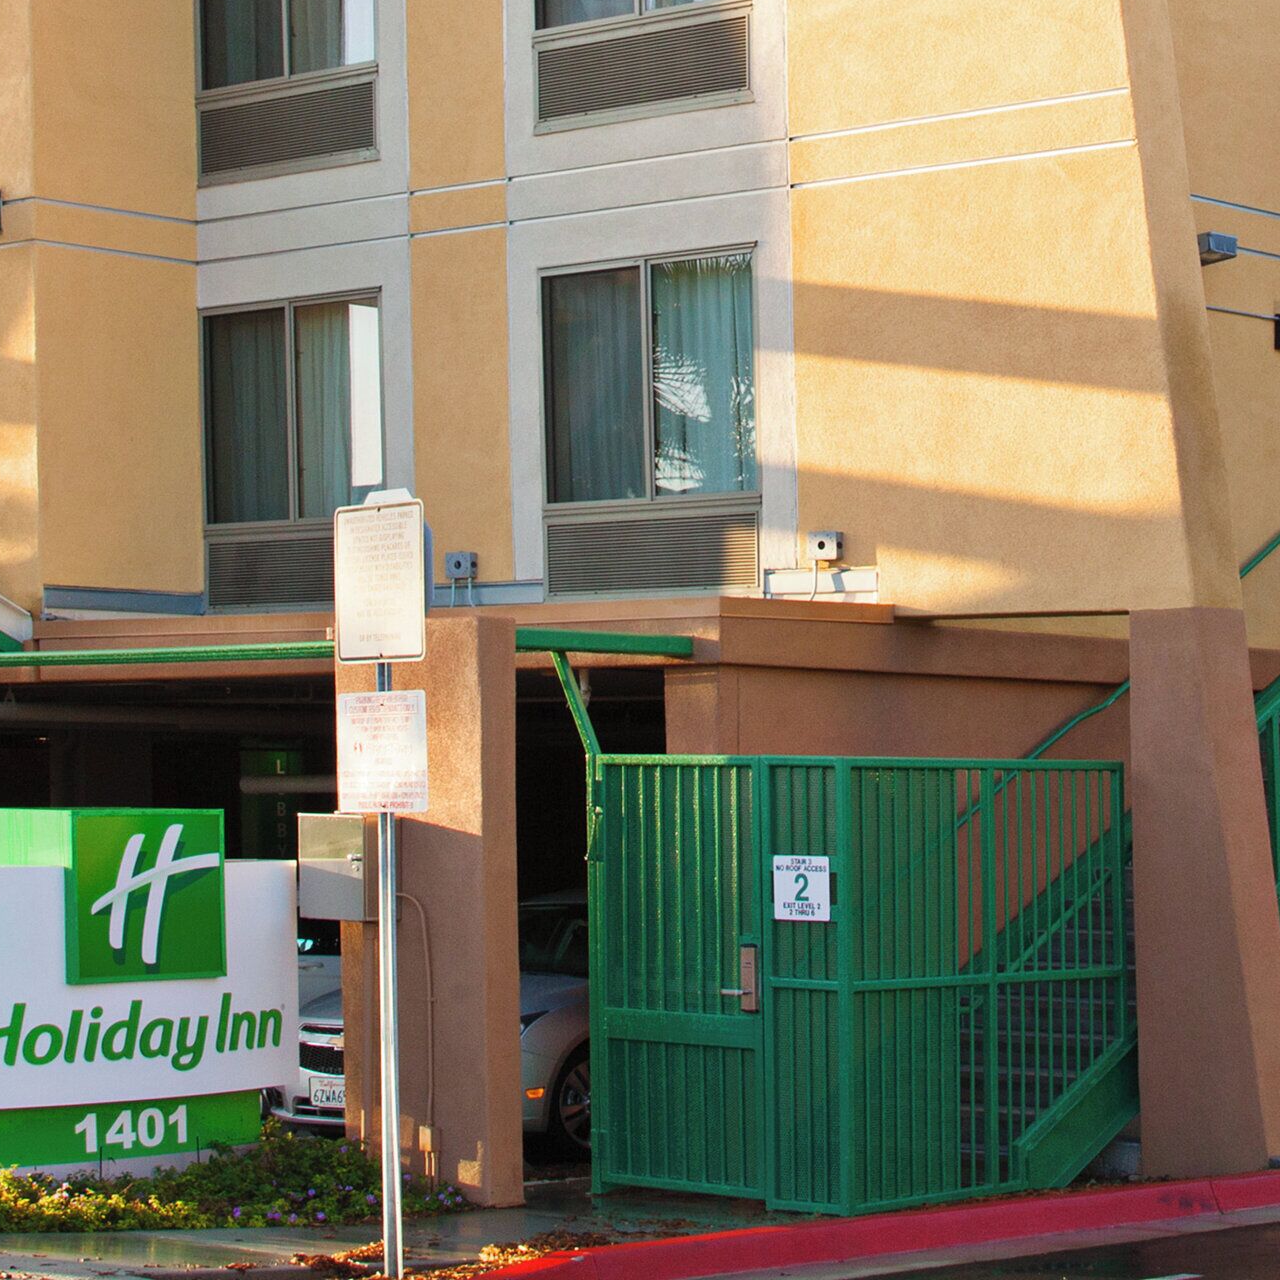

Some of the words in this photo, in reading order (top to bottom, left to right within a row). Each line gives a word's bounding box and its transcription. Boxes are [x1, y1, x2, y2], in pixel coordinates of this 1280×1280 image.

[276, 759, 288, 858] LBBY
[794, 873, 809, 901] 2
[215, 992, 283, 1053] Inn
[74, 1105, 188, 1153] 1401
